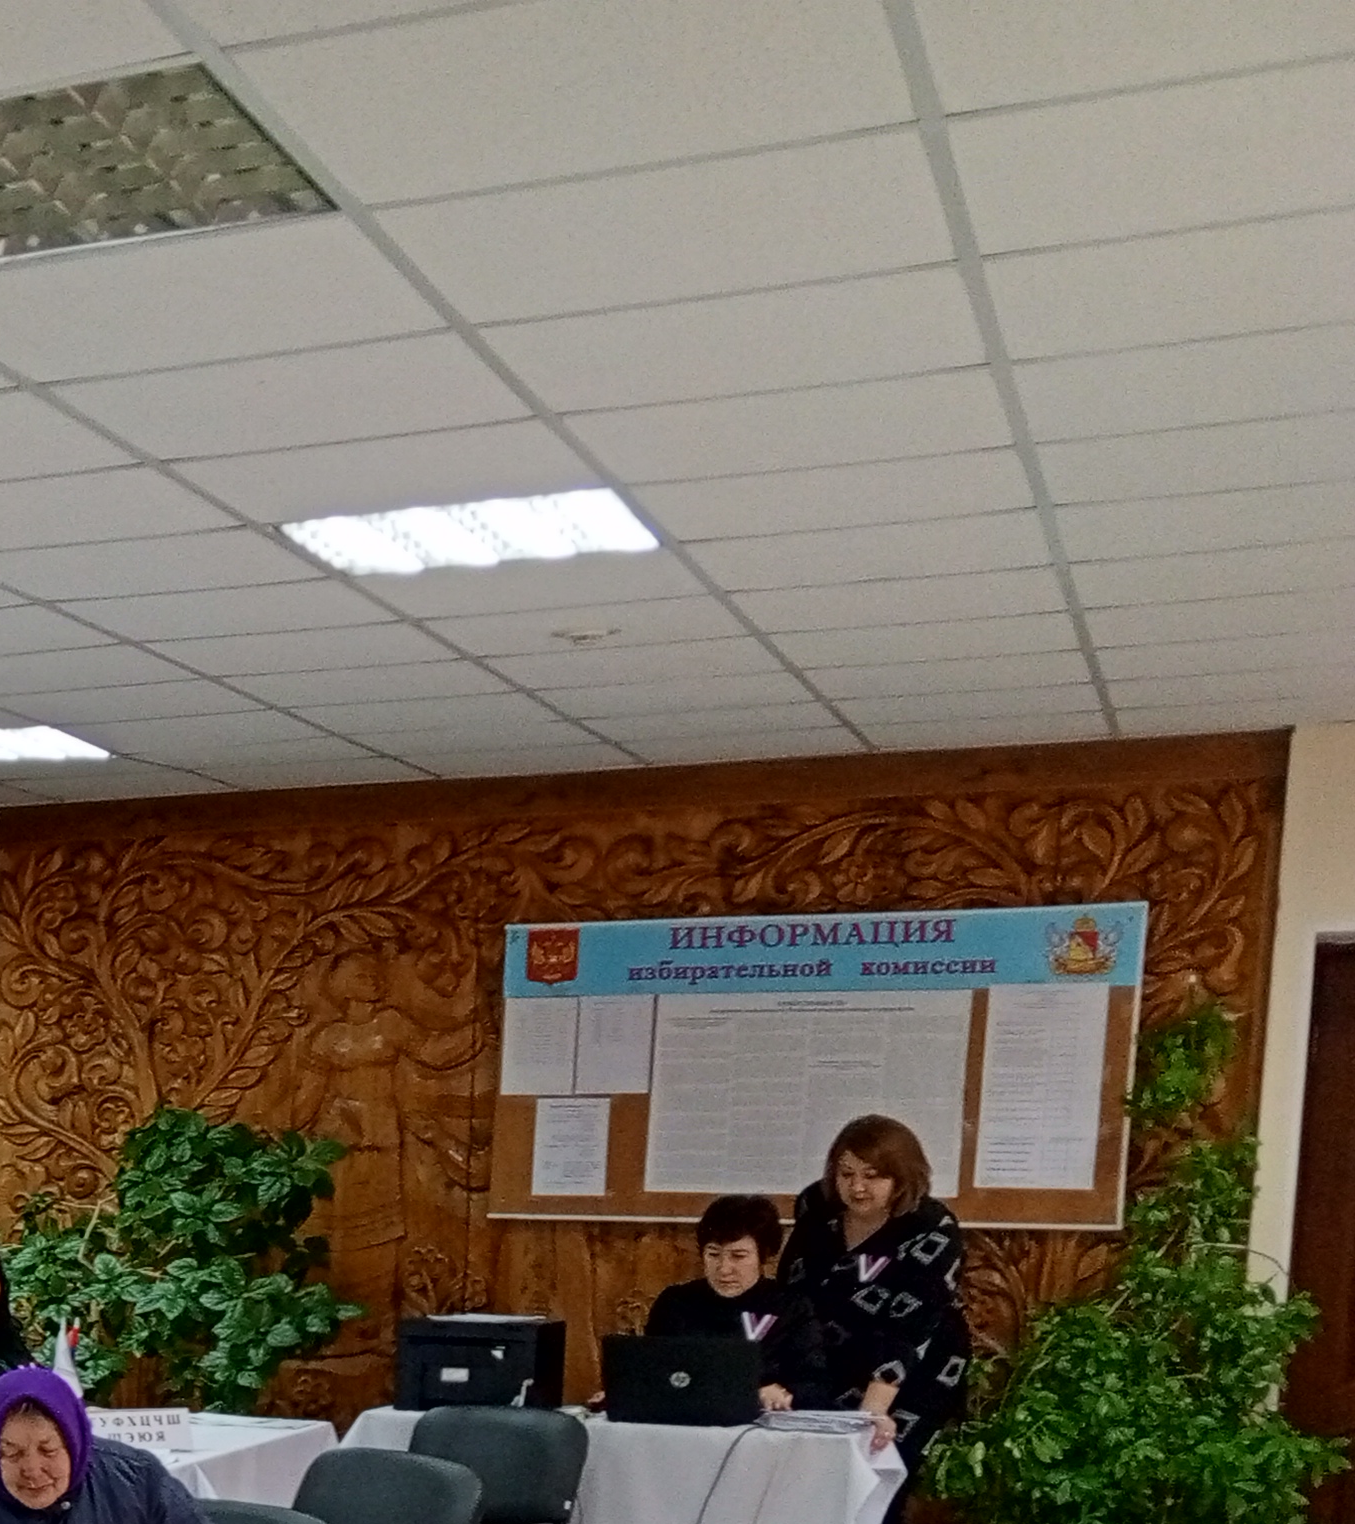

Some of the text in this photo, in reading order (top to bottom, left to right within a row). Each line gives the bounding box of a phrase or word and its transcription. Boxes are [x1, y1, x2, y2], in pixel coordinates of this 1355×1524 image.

[667, 918, 958, 950] ИНФОРМАЦИЯ
[627, 955, 998, 984] избирательной комиссии
[94, 1413, 181, 1428] УФХЦЧШ
